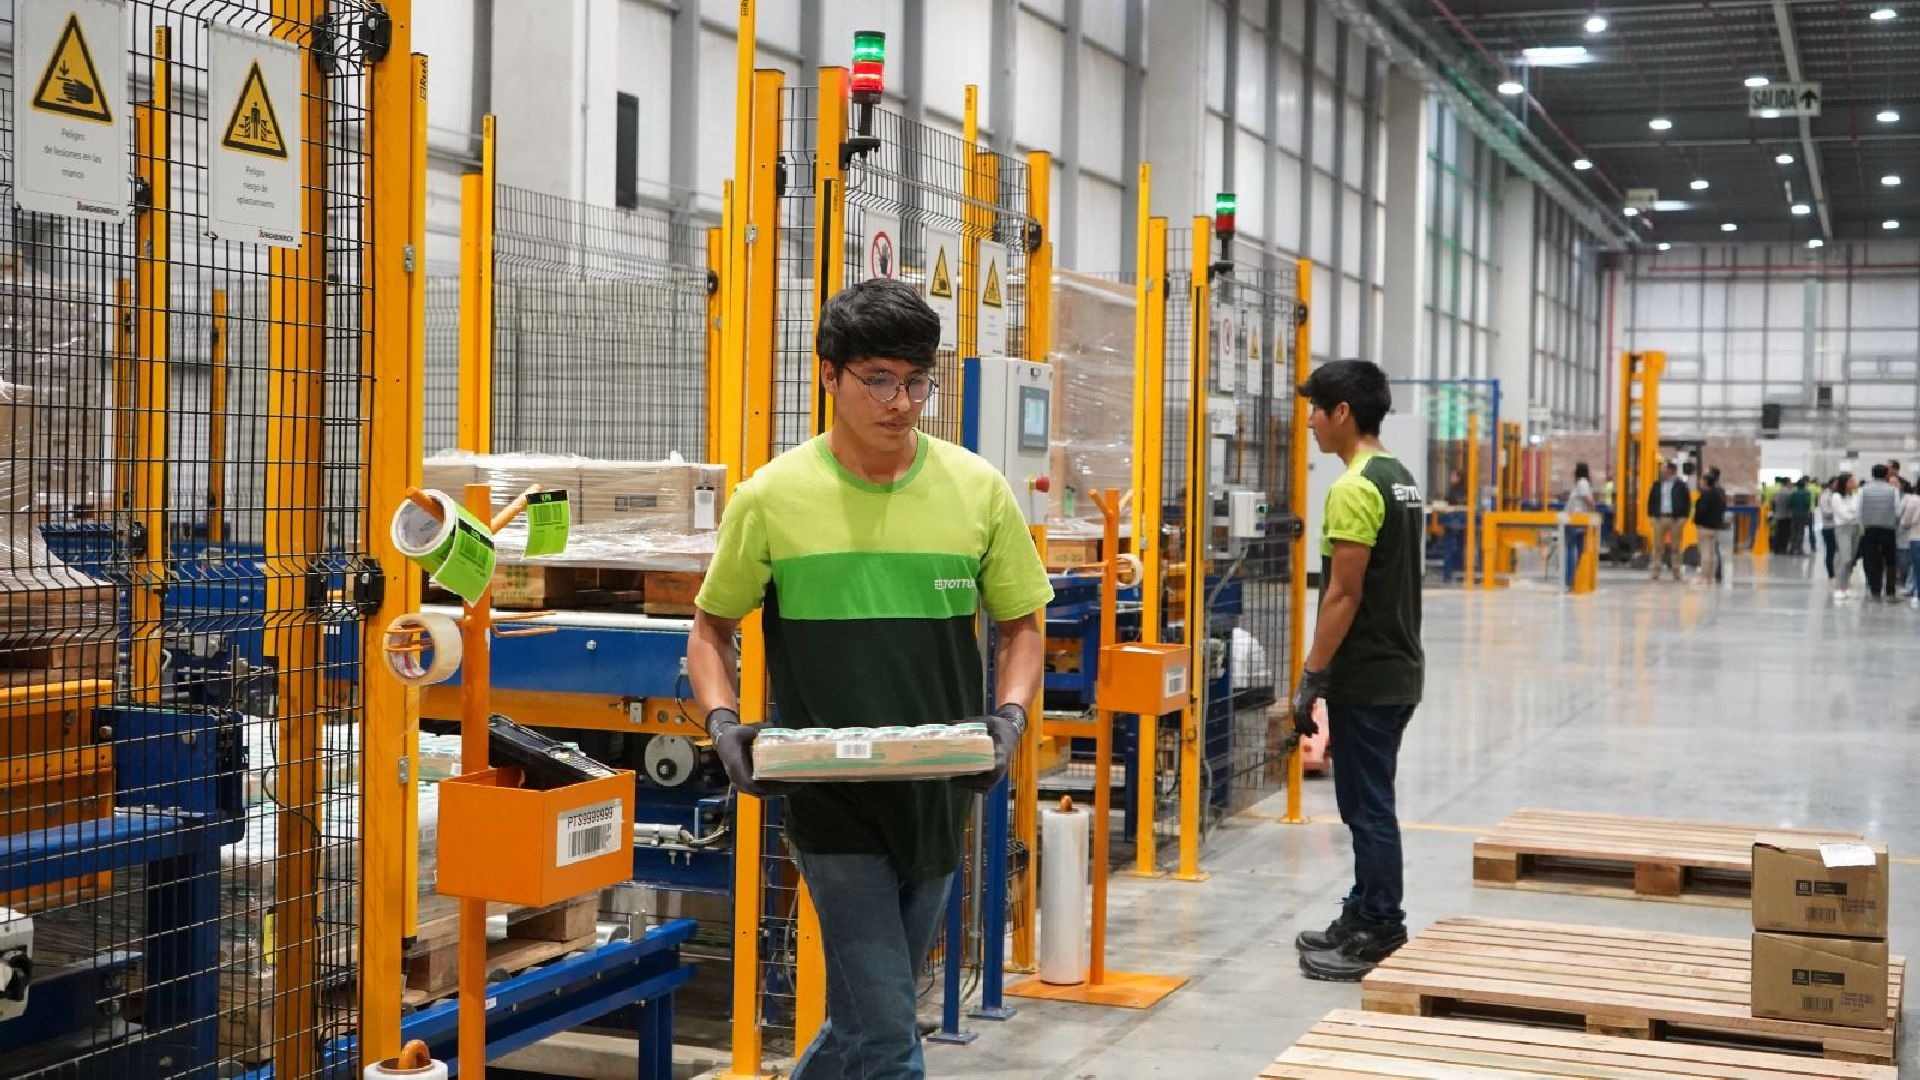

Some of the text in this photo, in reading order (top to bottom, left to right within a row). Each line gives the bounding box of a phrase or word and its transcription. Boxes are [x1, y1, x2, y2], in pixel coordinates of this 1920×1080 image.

[1753, 88, 1797, 110] SALIDA
[61, 127, 85, 141] Peligro
[43, 145, 102, 164] de lesiones en las
[61, 169, 85, 180] manos
[245, 165, 266, 177] Peligro
[941, 578, 976, 589] TOTTU
